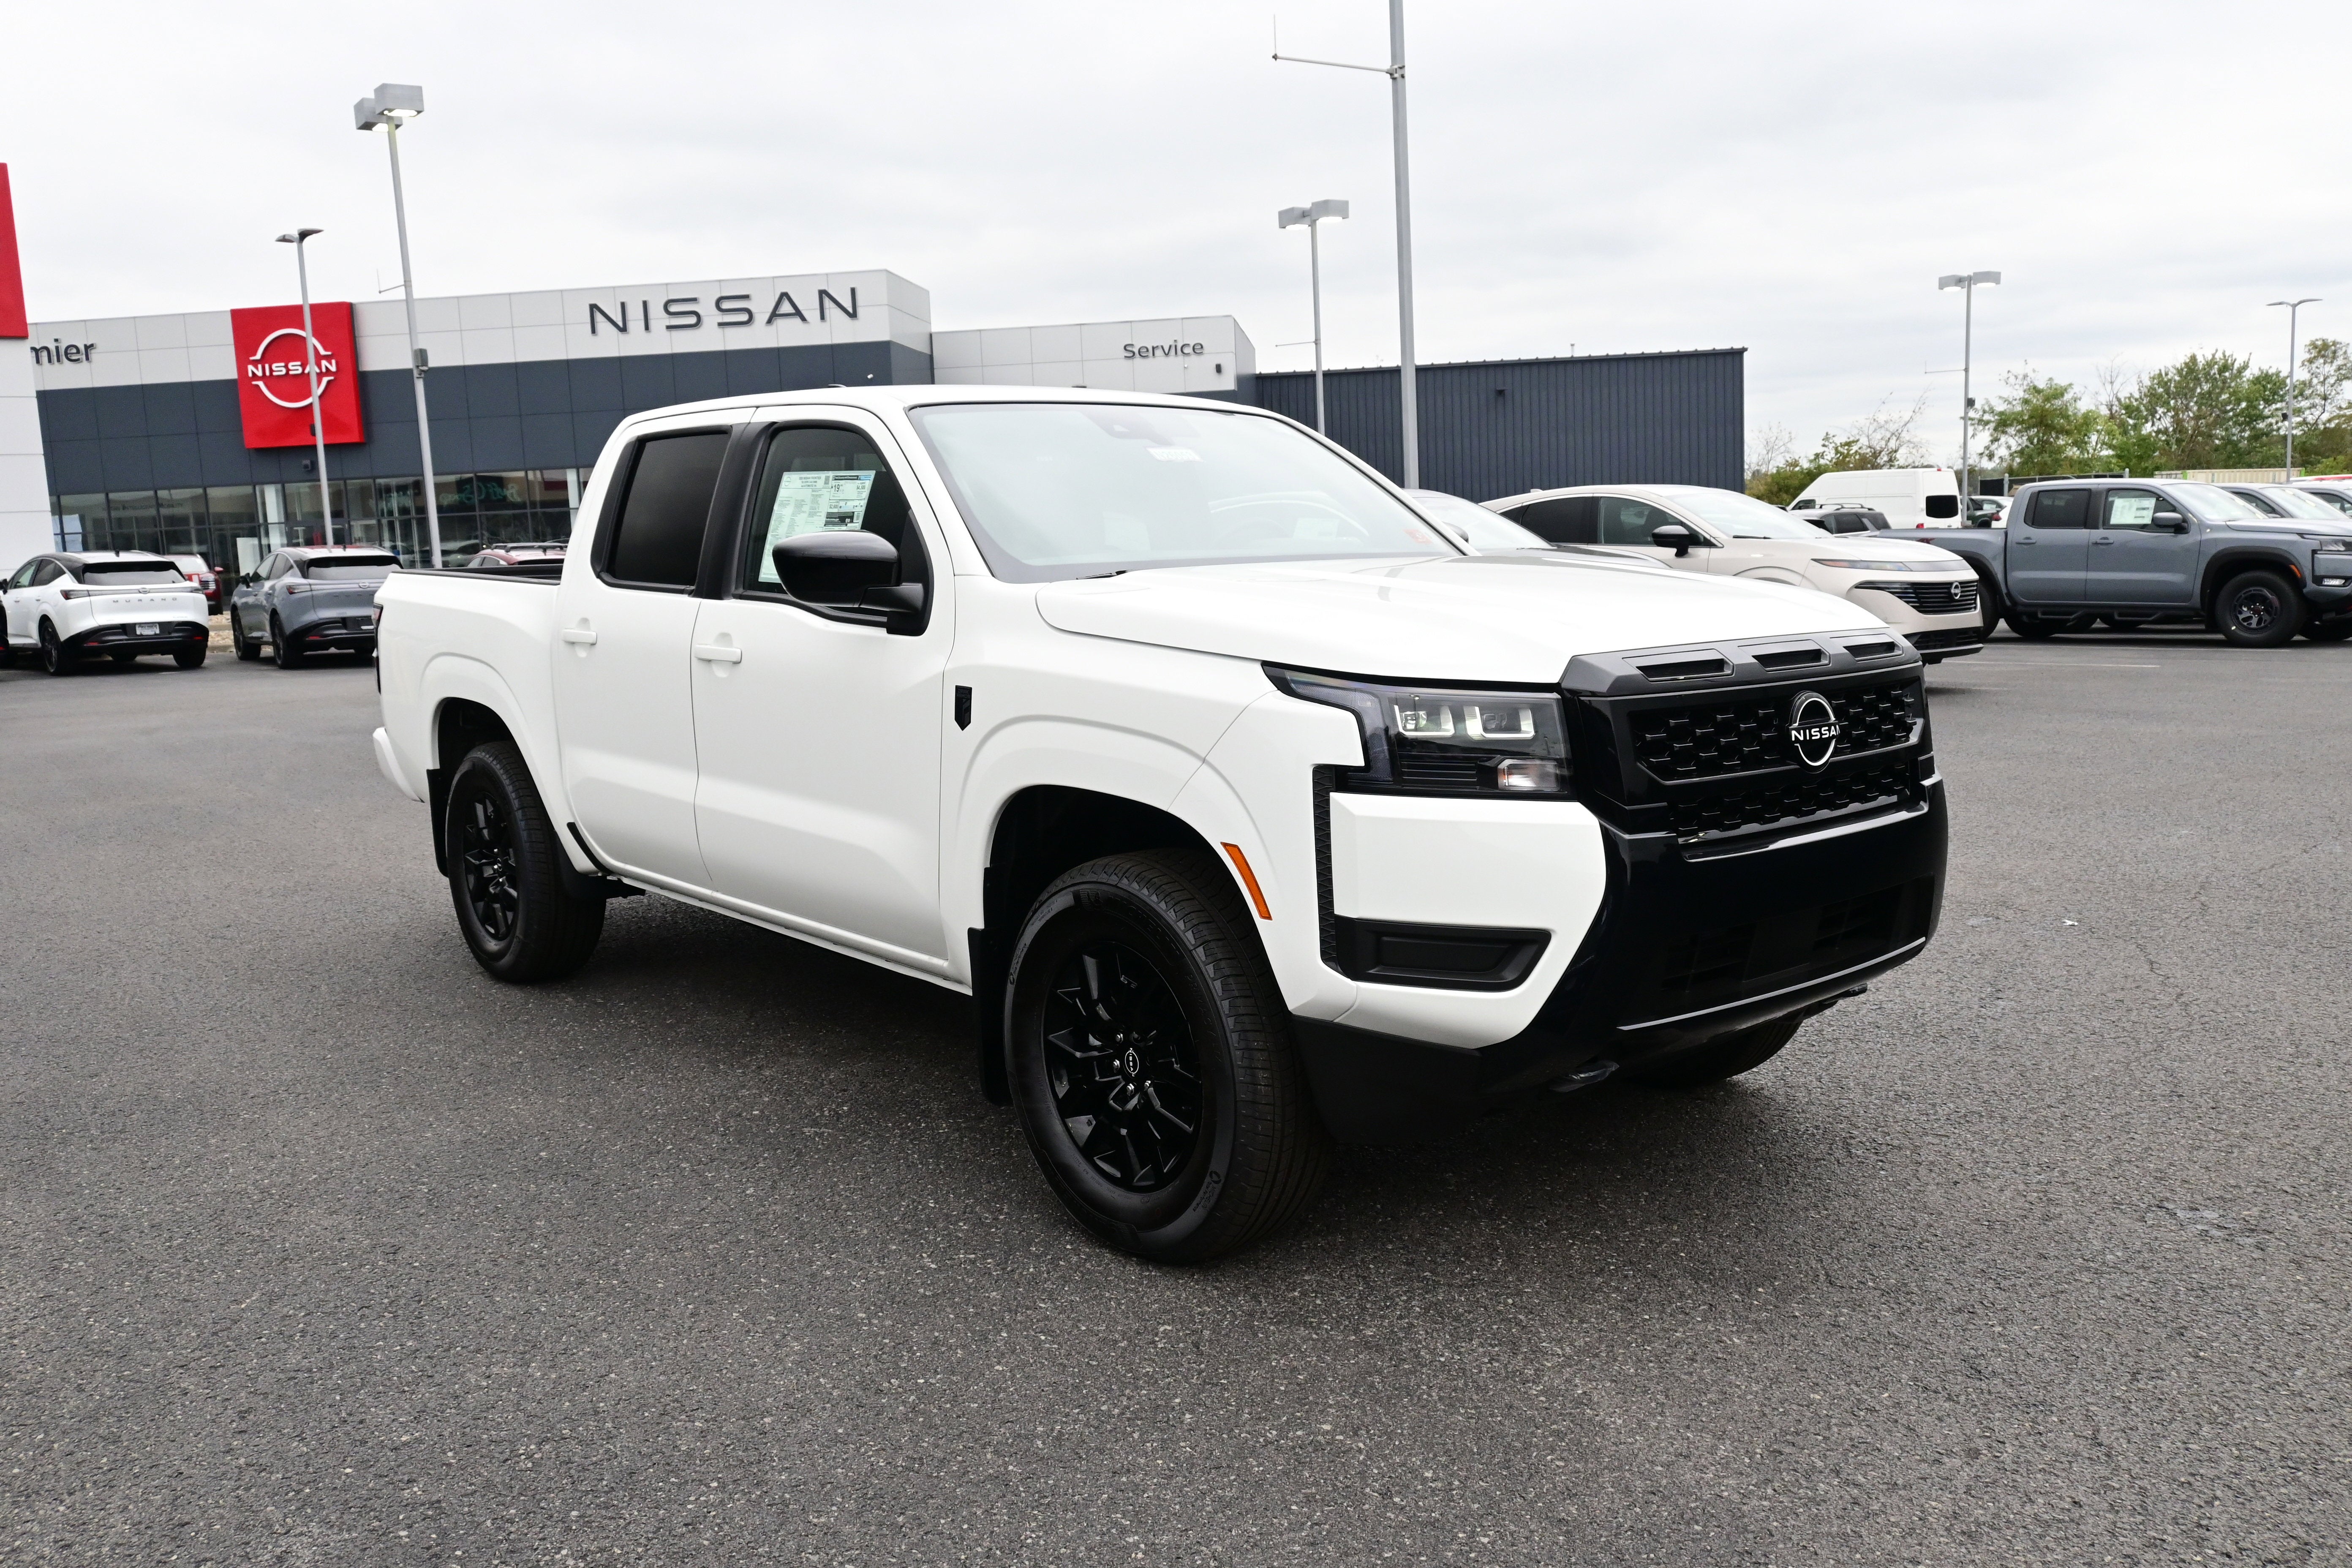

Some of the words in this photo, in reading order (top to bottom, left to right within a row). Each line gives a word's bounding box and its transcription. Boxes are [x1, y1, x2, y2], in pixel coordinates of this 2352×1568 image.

[588, 287, 858, 335] NISSAN
[30, 338, 95, 364] mier
[1123, 340, 1204, 359] Service
[247, 359, 337, 377] NISSAN
[834, 484, 840, 492] 19
[1791, 724, 1840, 741] NISSAN
